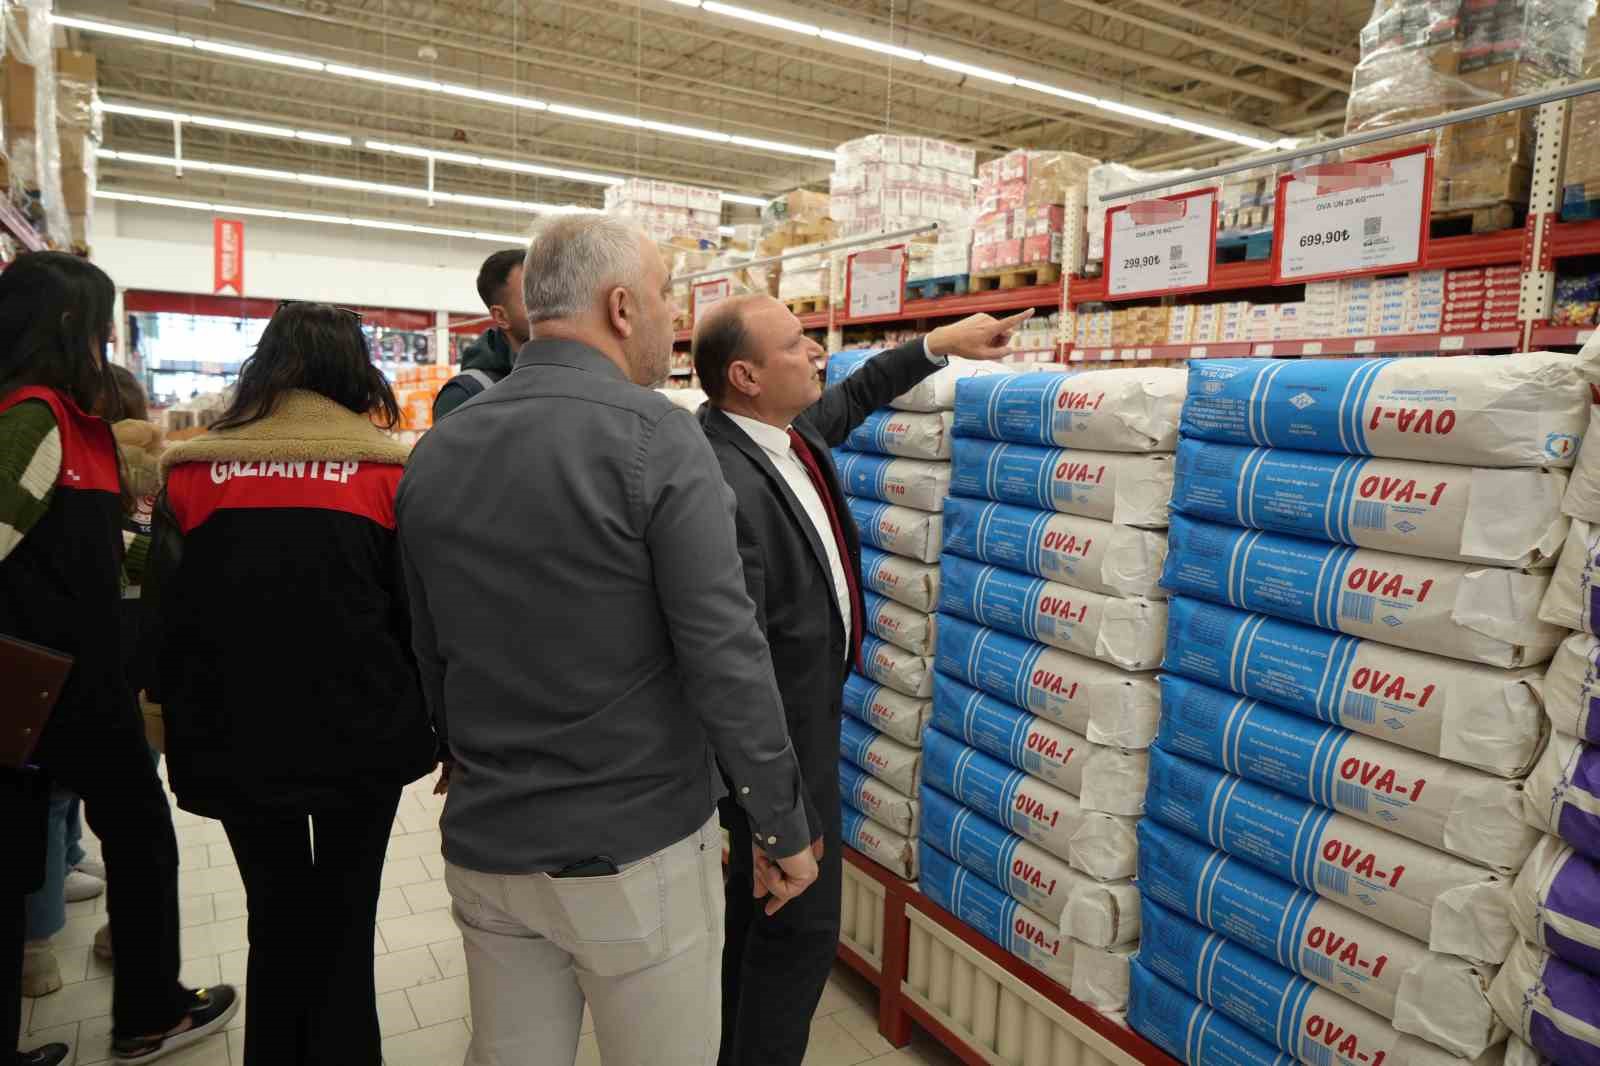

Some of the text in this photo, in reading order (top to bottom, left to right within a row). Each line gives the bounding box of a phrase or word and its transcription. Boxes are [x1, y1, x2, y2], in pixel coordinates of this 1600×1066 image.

[1299, 228, 1350, 248] 699,90₺
[1123, 254, 1161, 270] 299,90₺
[1058, 391, 1105, 410] OVA-1
[1369, 406, 1456, 434] OVA-1
[1056, 463, 1105, 484] OVA-1
[1359, 475, 1447, 506] OVA-1
[1044, 531, 1092, 556] OVA-1
[1348, 567, 1433, 603] OVA-1
[1039, 596, 1088, 623] OVA-1
[1033, 670, 1078, 699] OVA-1
[1352, 667, 1436, 708] OVA-1
[1028, 733, 1074, 764] OVA-1
[1340, 757, 1426, 801] OVA-1
[1016, 794, 1059, 827] OVA-1
[1013, 860, 1057, 896] OVA-1
[1322, 839, 1406, 889] OVA-1
[1015, 919, 1060, 955] OVA-1
[1307, 926, 1388, 977] OVA-1
[1306, 1015, 1386, 1066] OVA-1
